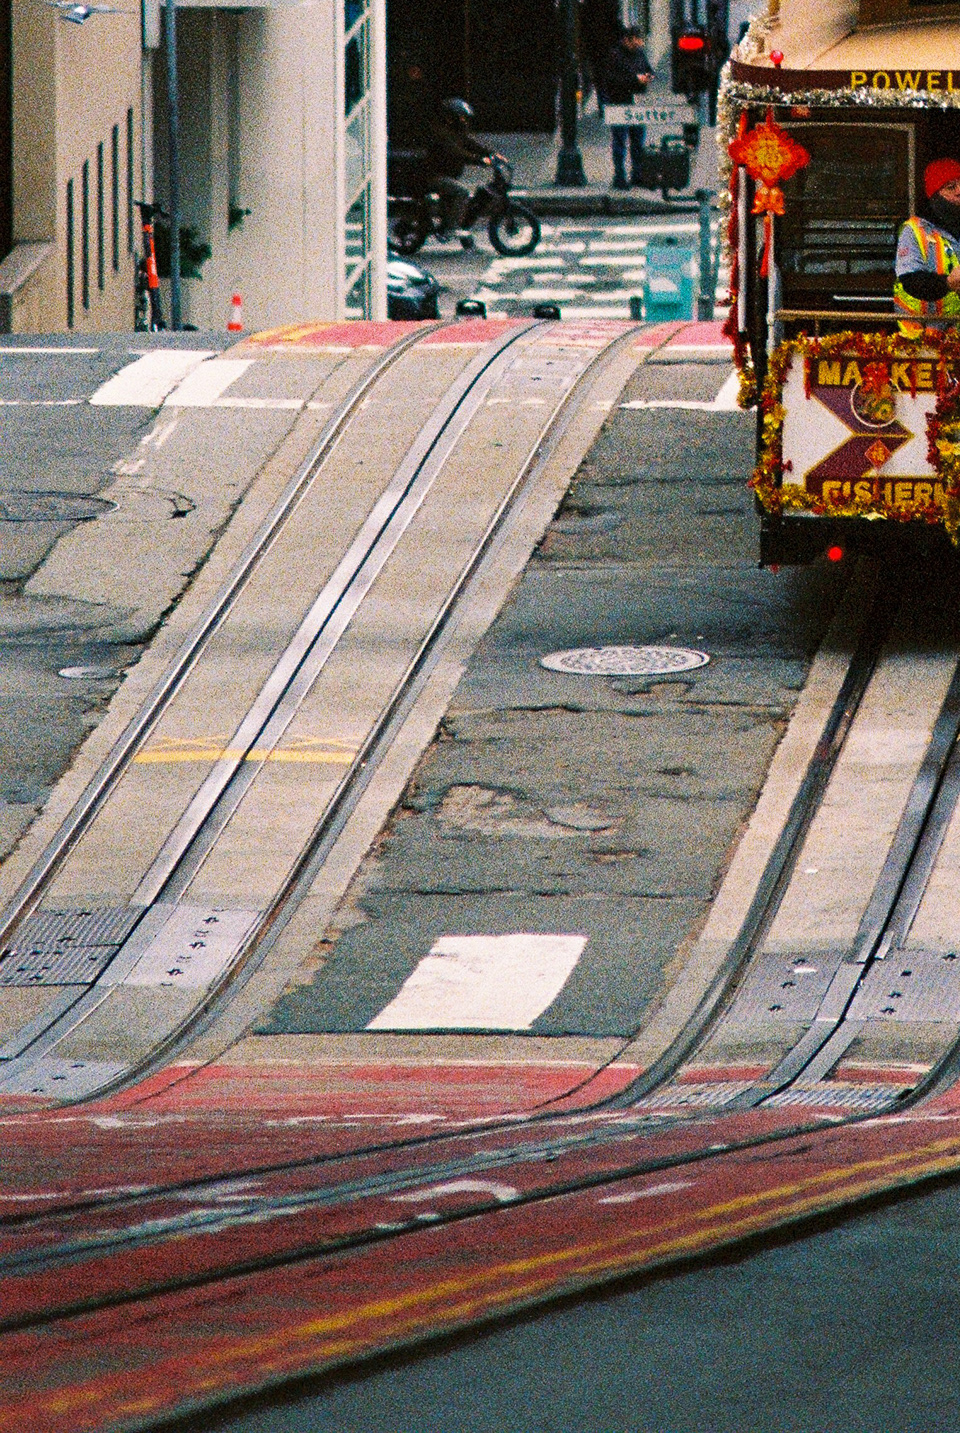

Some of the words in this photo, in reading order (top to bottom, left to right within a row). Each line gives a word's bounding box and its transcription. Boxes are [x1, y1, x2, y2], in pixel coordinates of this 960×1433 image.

[624, 108, 676, 121] Sutter
[818, 360, 954, 386] MAKET
[822, 480, 952, 508] FISHERM
